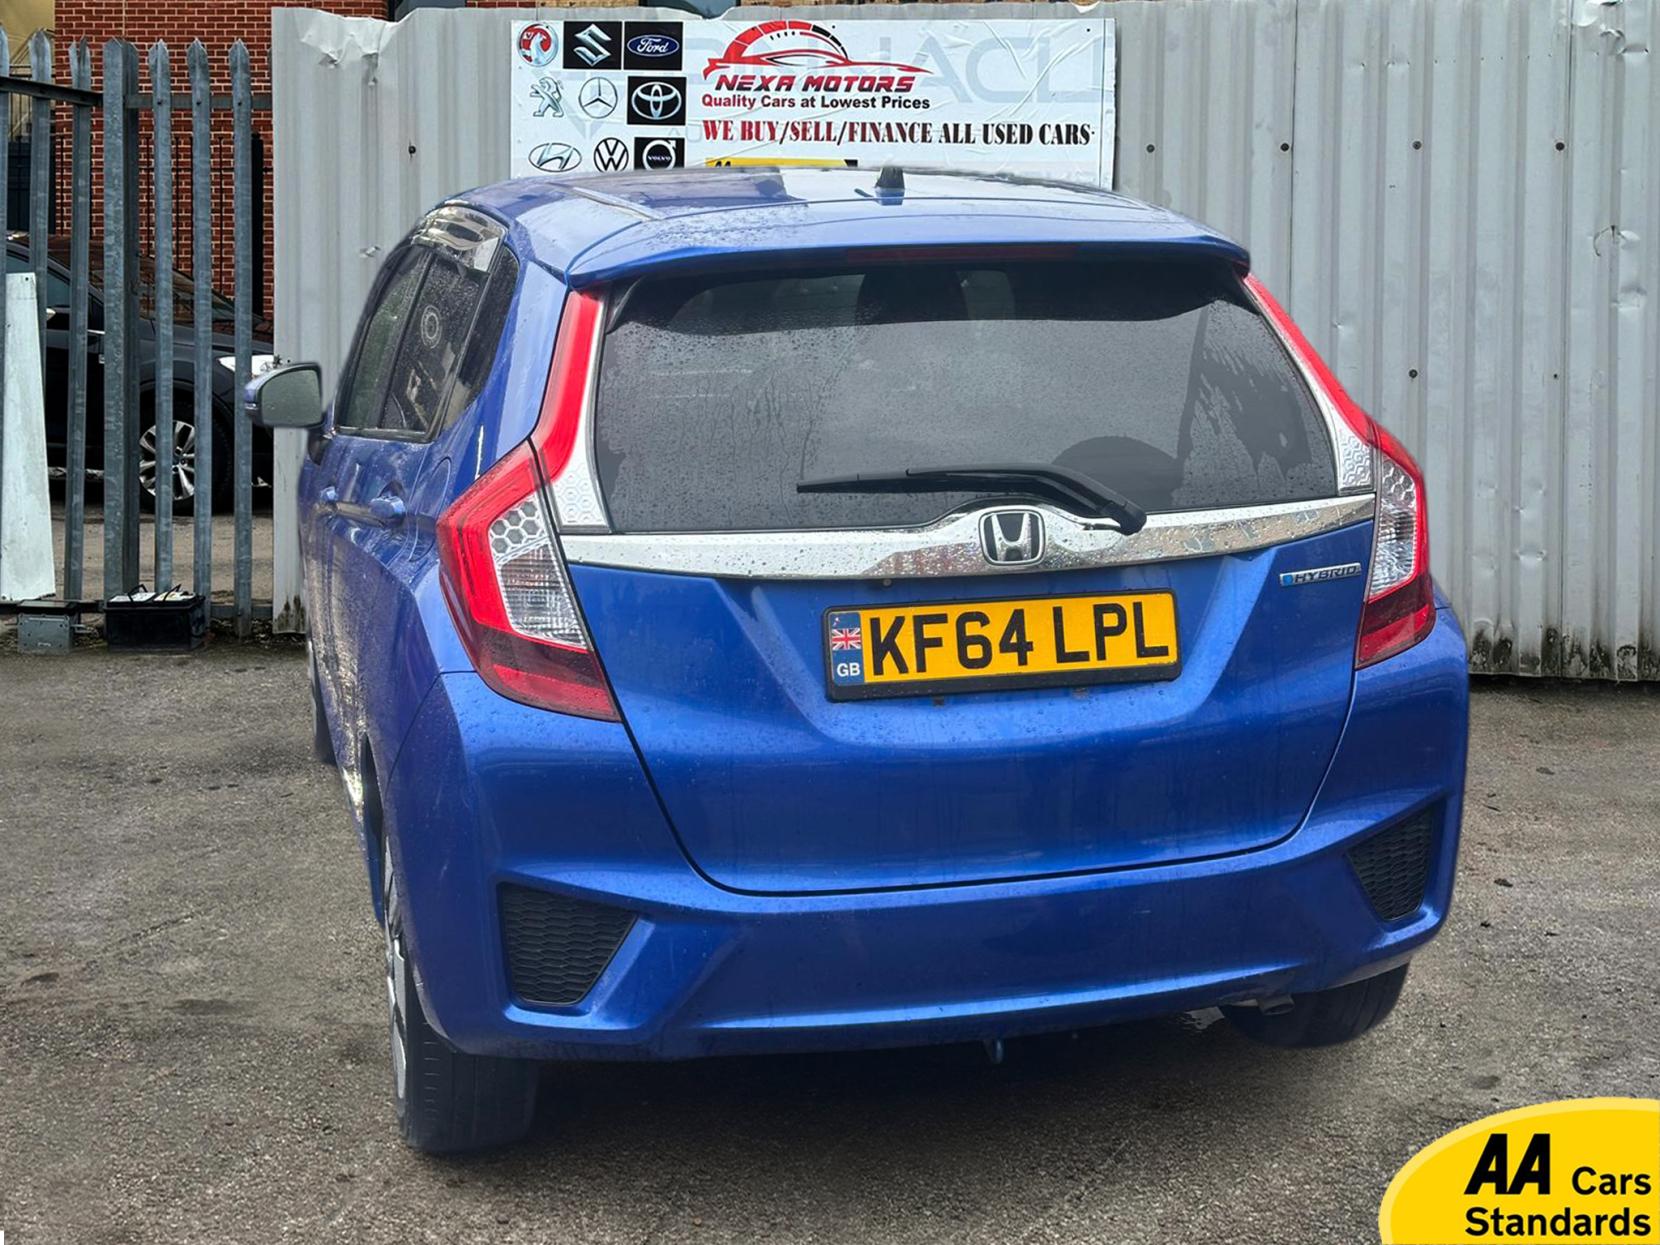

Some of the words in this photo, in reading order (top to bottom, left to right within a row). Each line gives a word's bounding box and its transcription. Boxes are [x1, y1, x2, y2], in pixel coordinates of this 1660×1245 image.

[636, 38, 669, 53] Ford
[714, 74, 797, 92] NEXA
[801, 75, 916, 93] MOTORS
[702, 93, 756, 110] Quality
[761, 95, 796, 108] Cars
[800, 95, 815, 108] at
[821, 95, 876, 109] Lowest
[882, 95, 930, 109] Prices
[702, 120, 734, 141] WE
[740, 120, 933, 145] BUY/SELL/FINANCE
[939, 122, 976, 144] ALL
[982, 123, 1033, 145] USED
[1038, 123, 1091, 145] CARS
[1294, 565, 1357, 583] HYBRID
[869, 608, 1034, 677] KF64
[1052, 601, 1170, 664] LPL
[836, 662, 861, 678] GB
